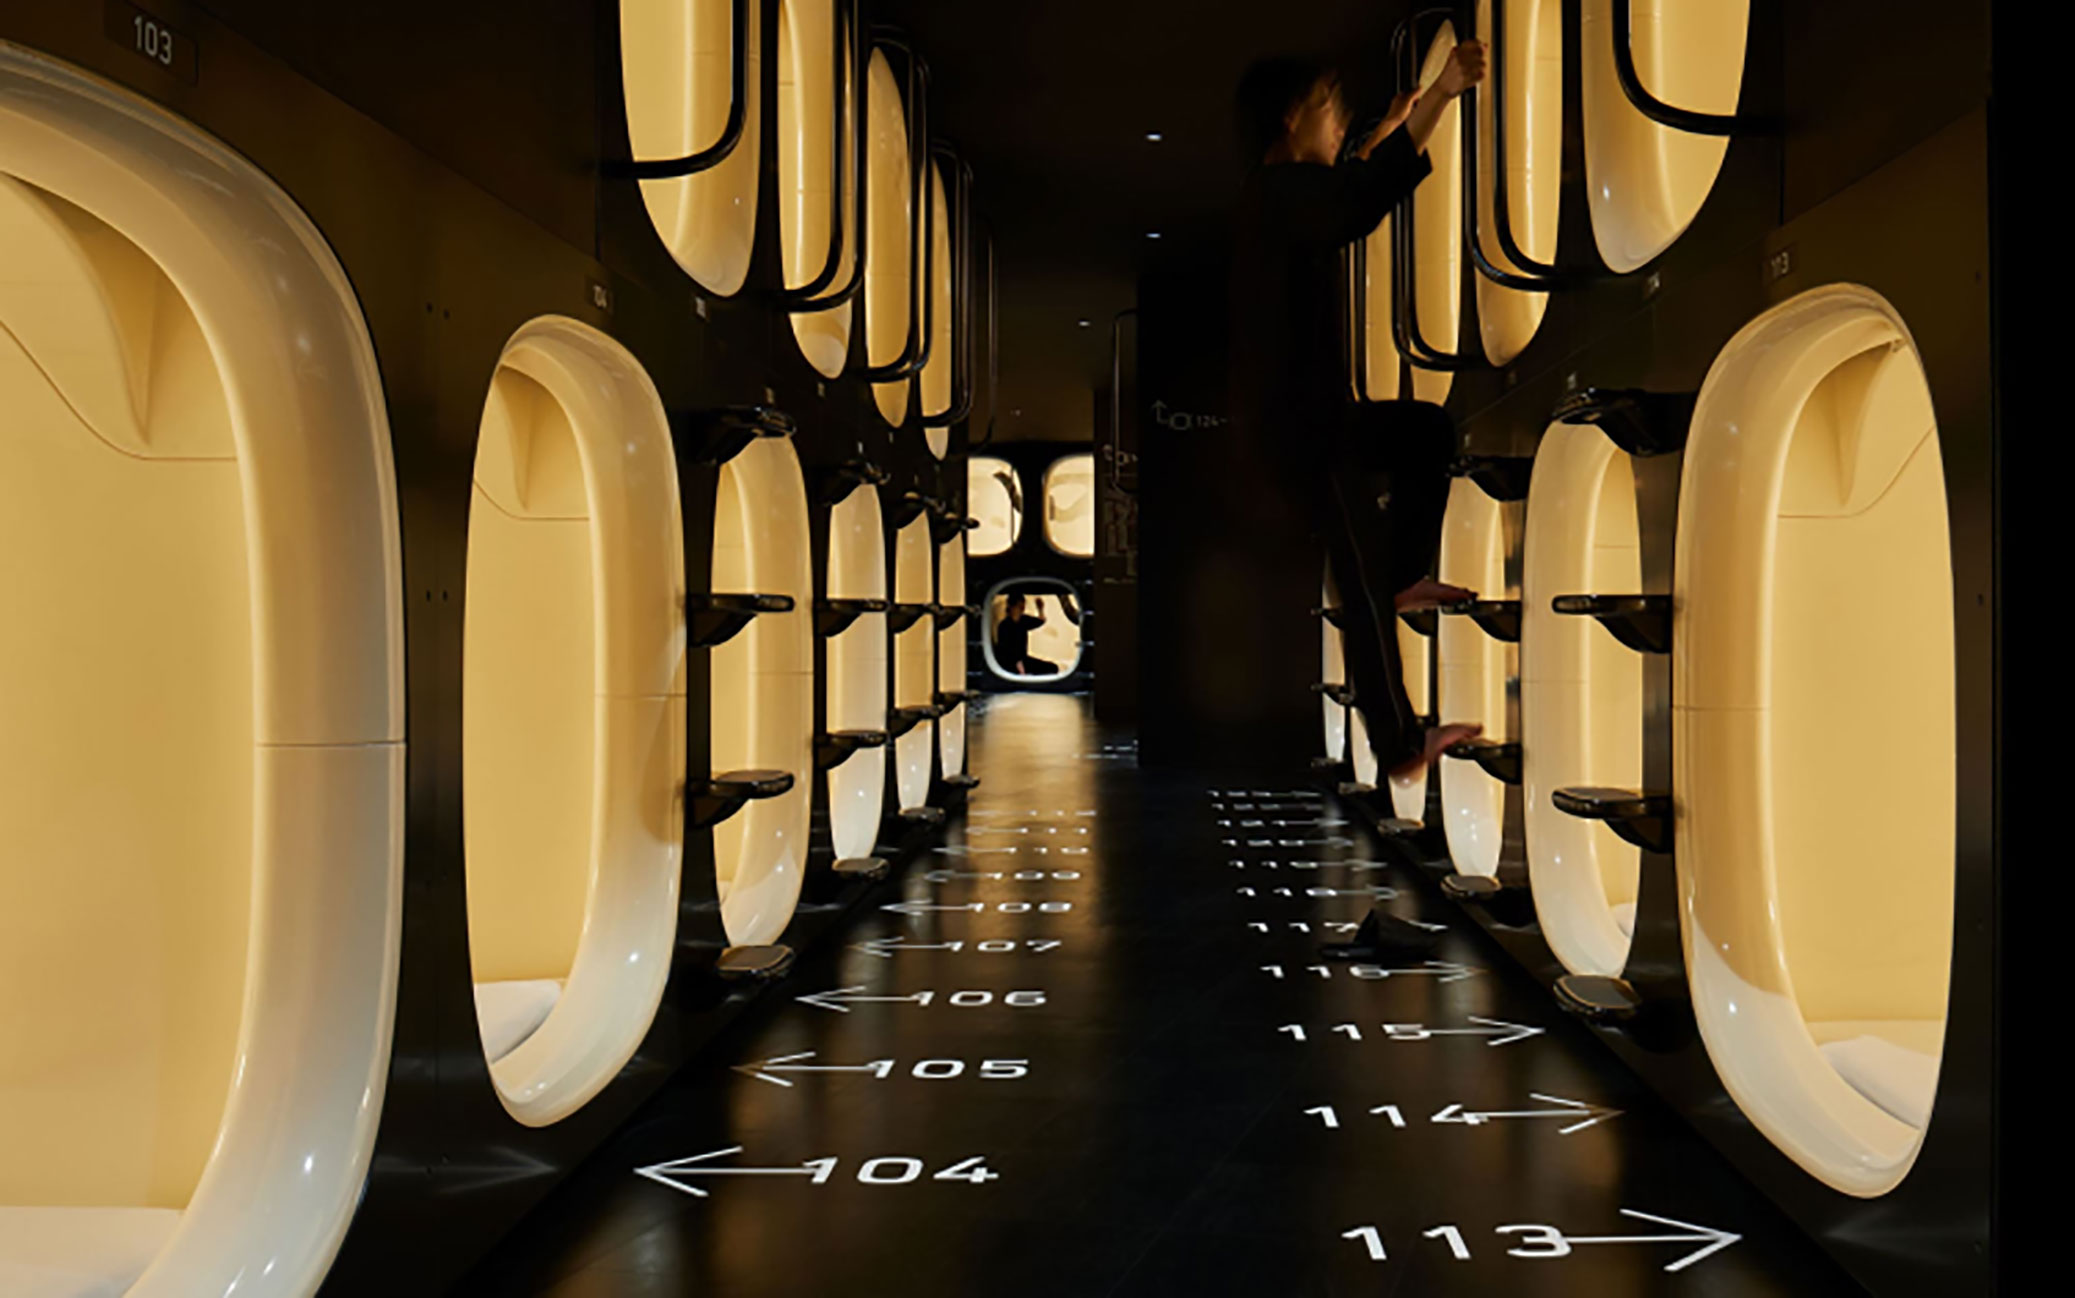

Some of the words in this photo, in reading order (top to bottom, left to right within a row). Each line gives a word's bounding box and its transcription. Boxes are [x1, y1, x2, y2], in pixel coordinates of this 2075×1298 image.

[134, 15, 172, 65] 103
[944, 939, 1062, 953] 107
[1260, 964, 1389, 979] 116
[912, 990, 1048, 1007] 106
[1277, 1023, 1431, 1041] 115
[868, 1058, 1029, 1079] 105
[1303, 1103, 1488, 1128] 114
[803, 1156, 1000, 1184] 104
[1341, 1224, 1573, 1261] 113
